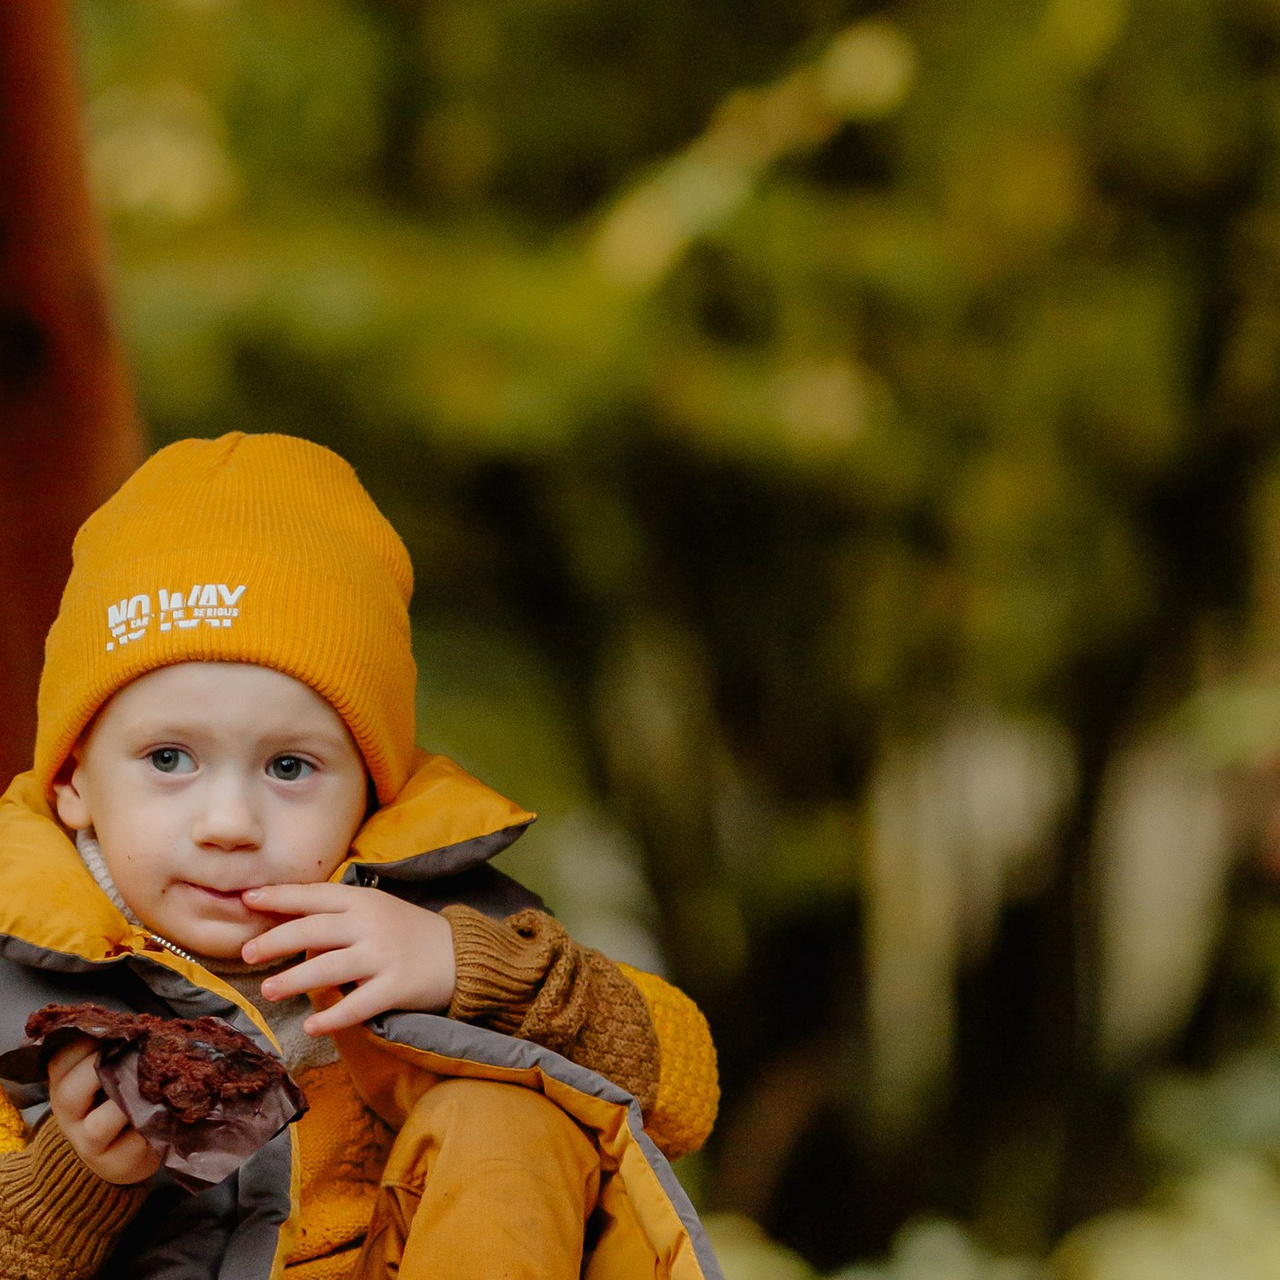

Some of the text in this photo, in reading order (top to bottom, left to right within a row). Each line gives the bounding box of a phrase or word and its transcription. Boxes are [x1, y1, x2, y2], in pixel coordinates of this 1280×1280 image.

[106, 583, 247, 651] NO WAY
[193, 607, 239, 617] SERIOUS
